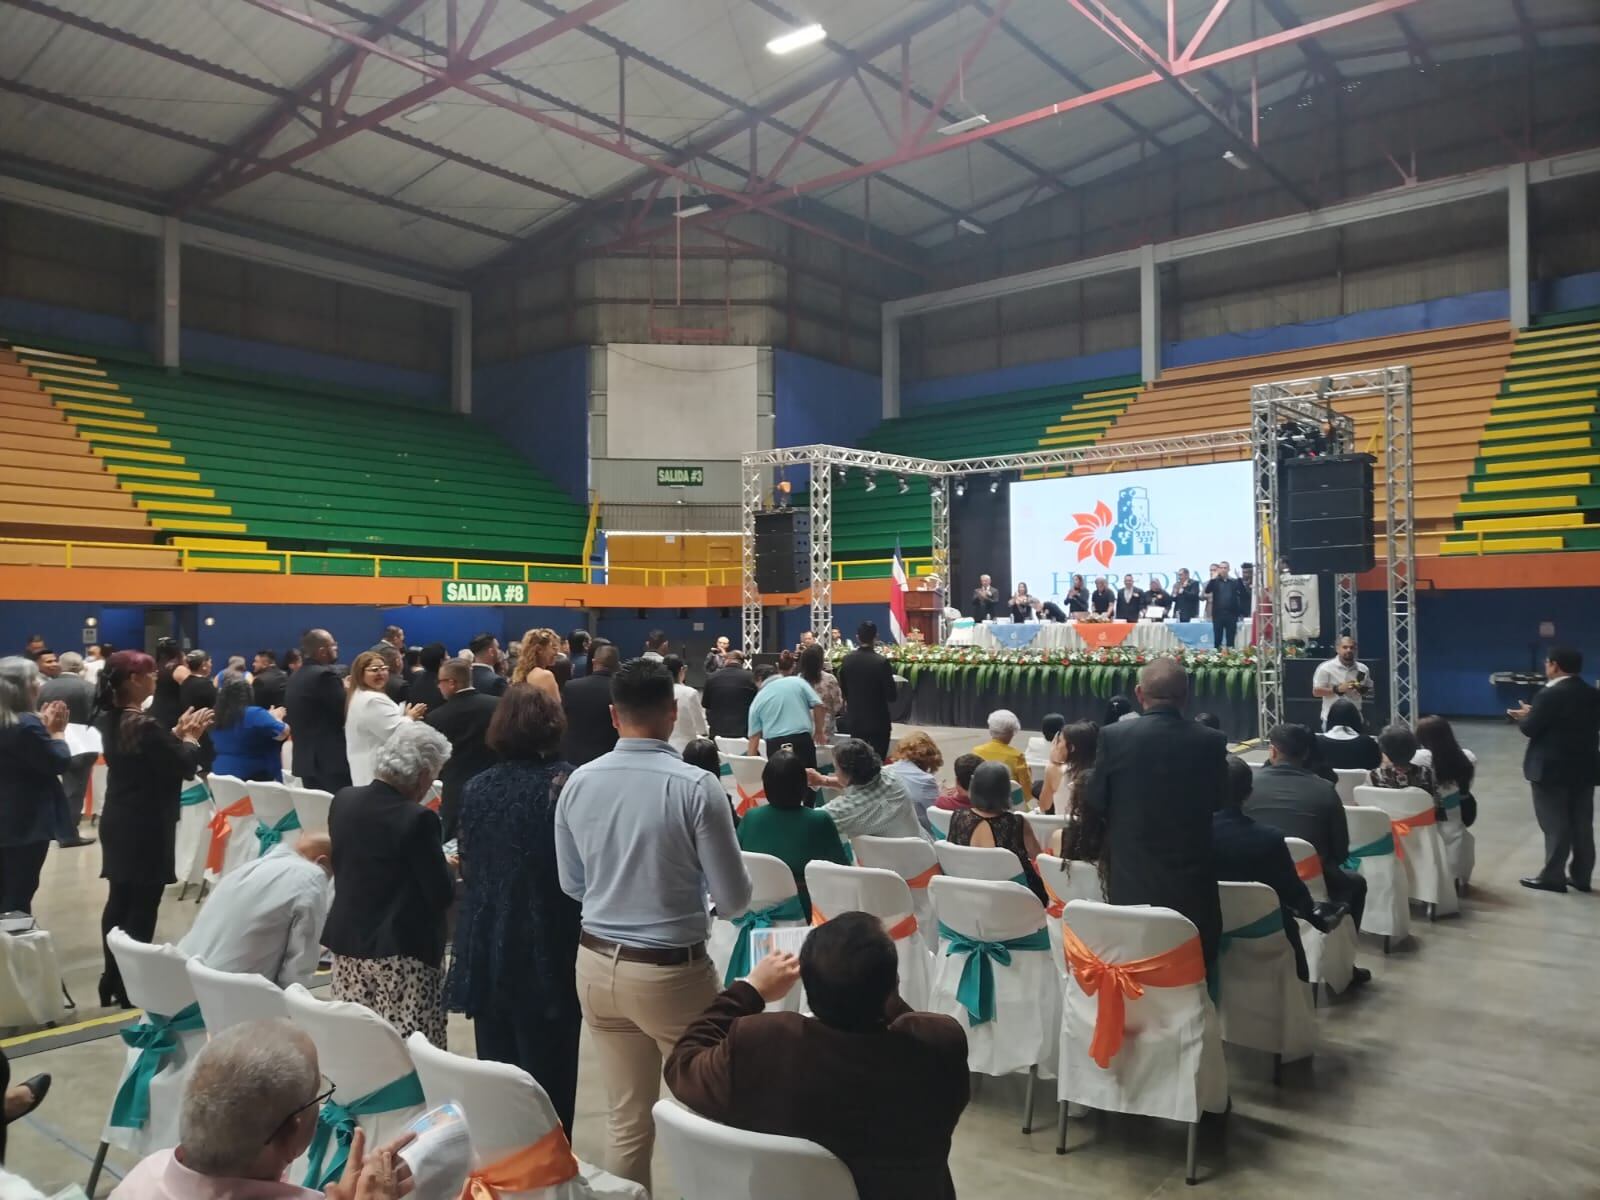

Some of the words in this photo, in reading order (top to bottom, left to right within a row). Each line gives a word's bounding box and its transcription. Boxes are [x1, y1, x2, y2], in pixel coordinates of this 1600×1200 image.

[659, 470, 689, 482] SALIDA
[447, 583, 502, 601] SALIDA
[504, 585, 524, 602] #8
[1052, 571, 1206, 596] HERD
